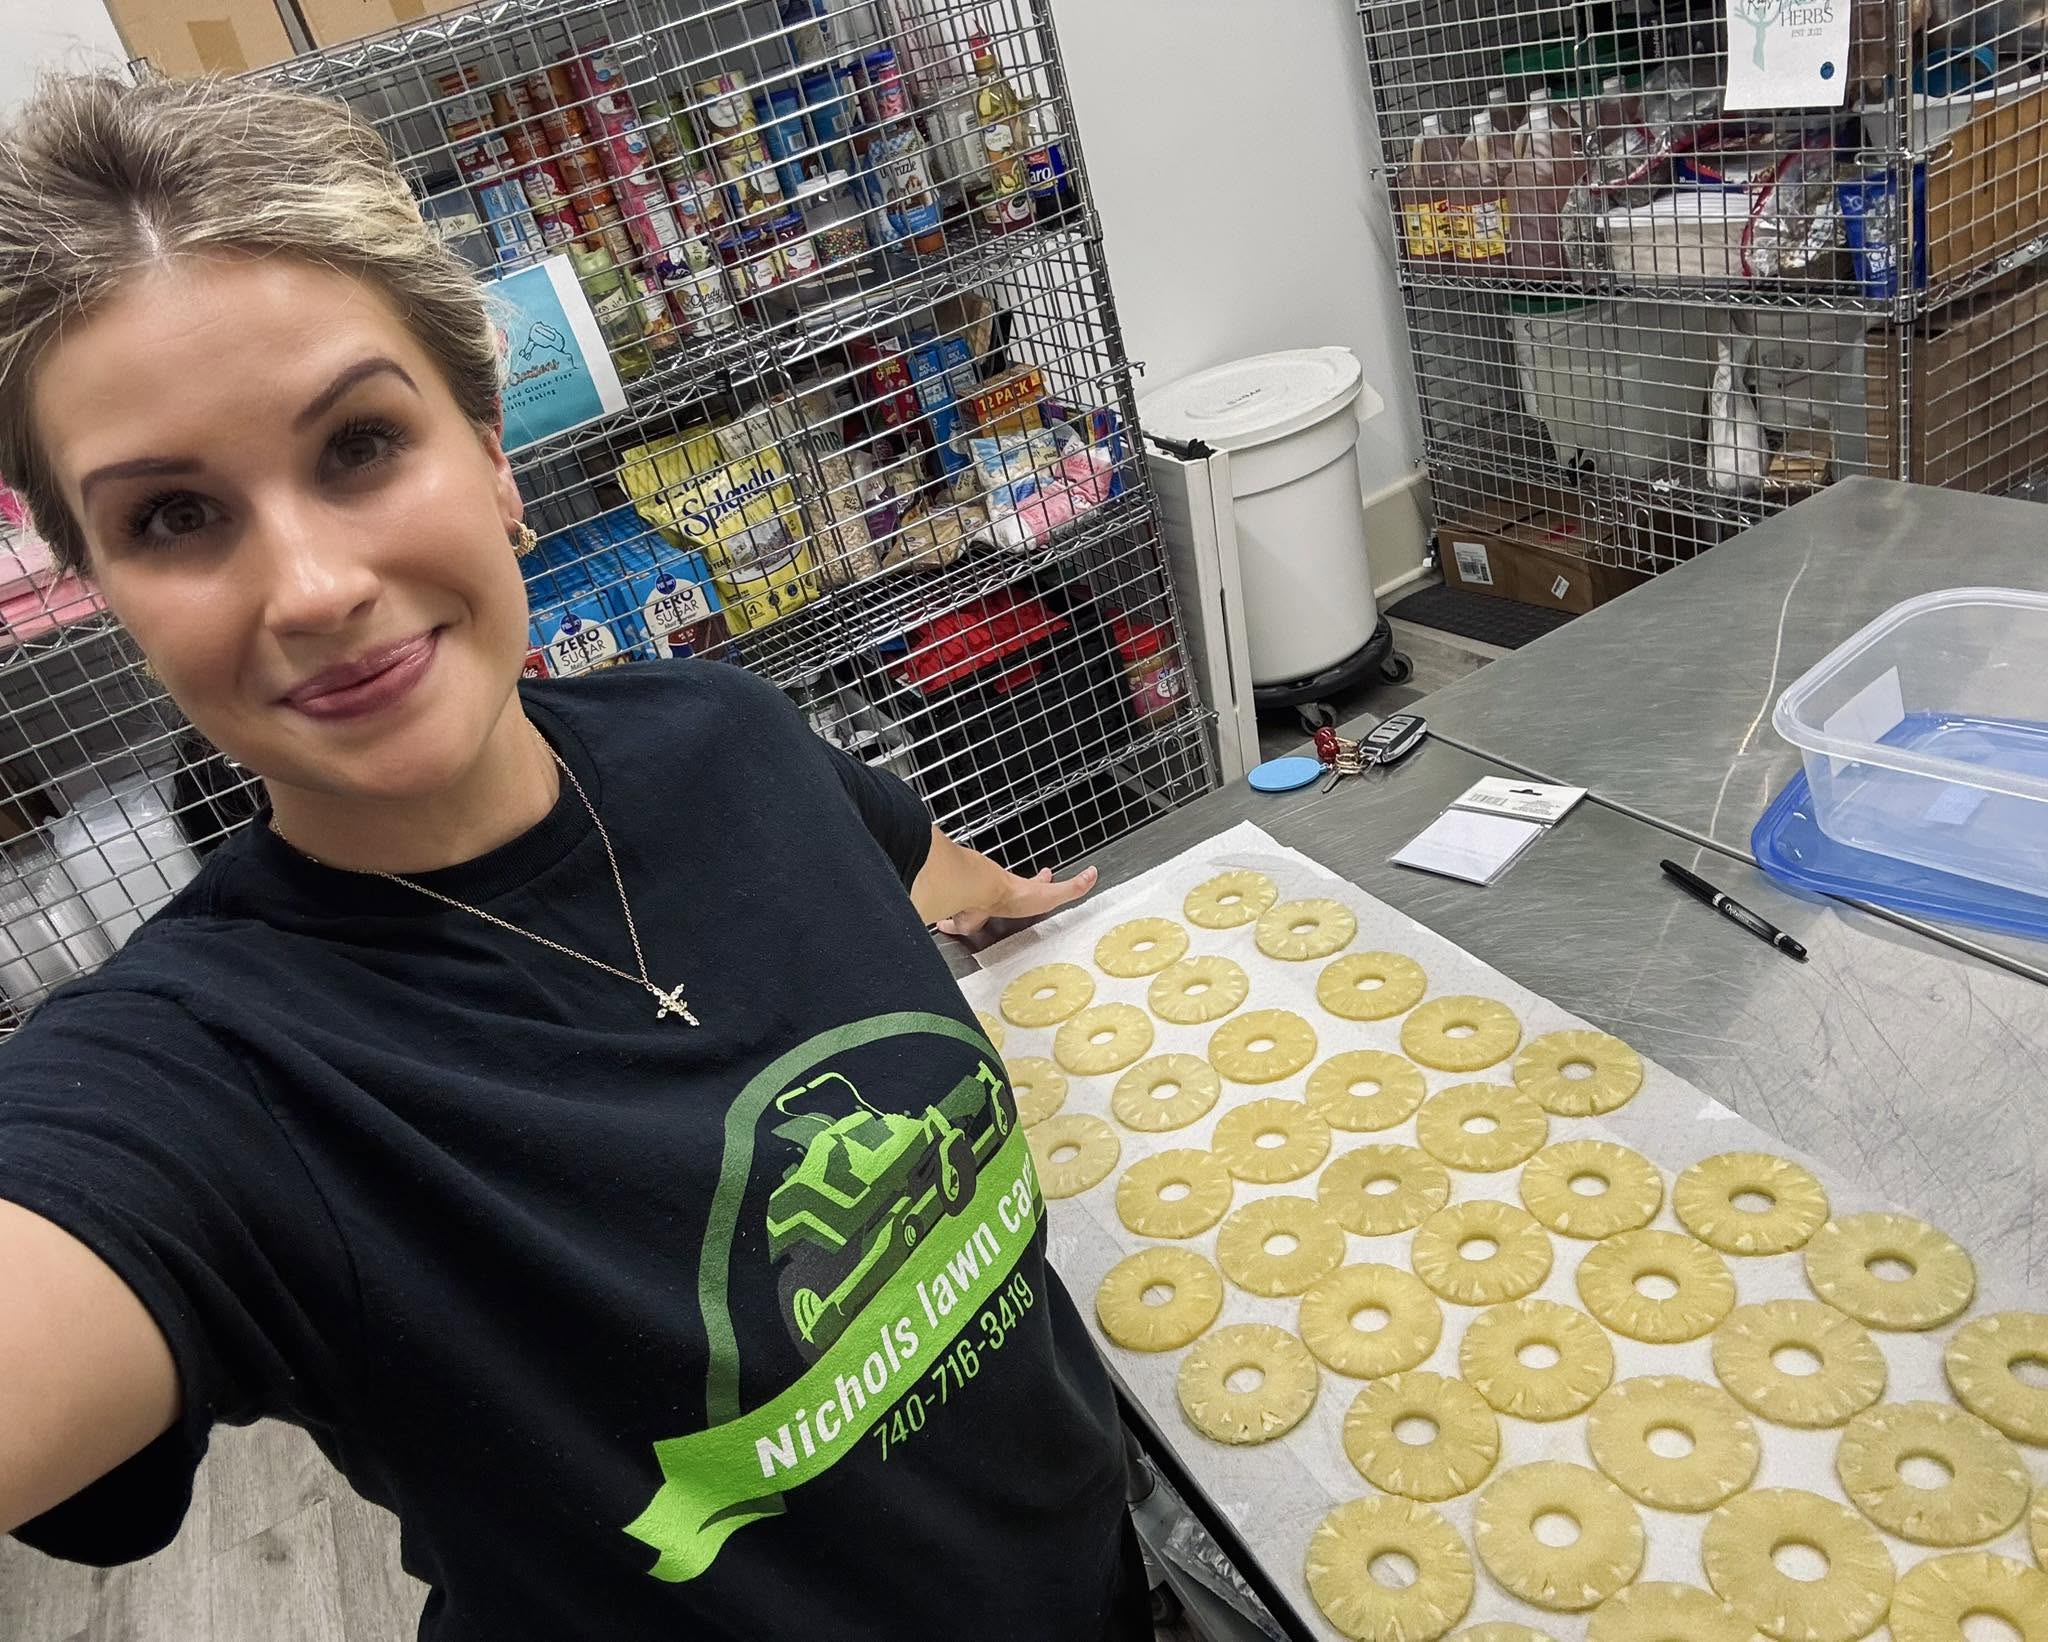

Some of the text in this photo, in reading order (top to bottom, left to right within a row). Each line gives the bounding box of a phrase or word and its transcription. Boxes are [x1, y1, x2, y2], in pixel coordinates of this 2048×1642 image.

[1781, 7, 1834, 27] HERBS
[1029, 166, 1053, 183] aro
[524, 381, 552, 395] Gluten
[555, 373, 572, 383] Free
[995, 380, 1030, 407] PACK
[503, 389, 556, 413] cialty Baking
[682, 467, 777, 537] Splenda
[654, 589, 693, 615] ZERO
[656, 599, 700, 626] SUGAR
[556, 628, 600, 656] ZERO
[561, 639, 607, 667] SUGAR
[755, 1316, 919, 1479] Nichols
[916, 1221, 1001, 1329] lawn
[873, 1272, 1034, 1461] 740-716-3419
